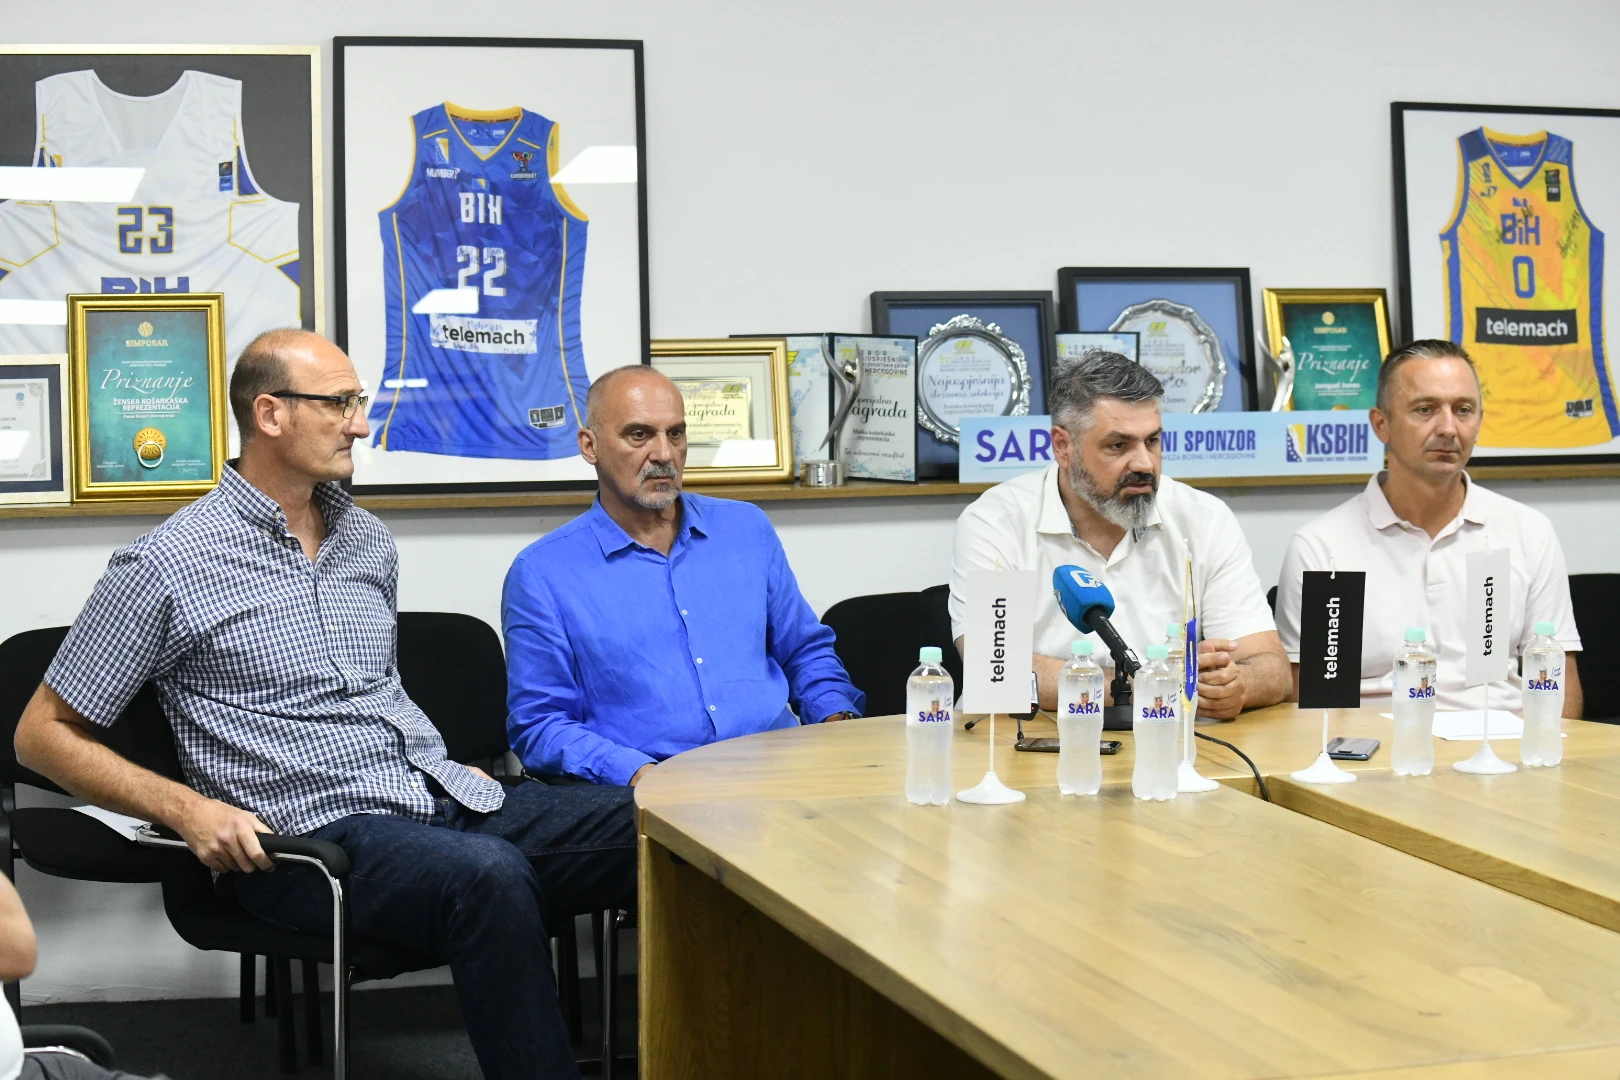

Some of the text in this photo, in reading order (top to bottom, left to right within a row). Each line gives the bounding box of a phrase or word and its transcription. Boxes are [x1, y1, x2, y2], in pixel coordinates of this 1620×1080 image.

[459, 192, 503, 225] BIH
[117, 205, 175, 254] 23
[1500, 213, 1541, 246] BiH
[456, 245, 507, 297] 22
[1512, 256, 1536, 299] 0
[442, 324, 525, 345] telemach
[1485, 317, 1569, 337] telemach
[125, 339, 168, 347] SIMPOSAR
[1298, 352, 1369, 382] Priznanje
[100, 368, 195, 398] Priznanje
[113, 397, 188, 406] ŽENSKA KOŠARKAŠKA
[685, 404, 735, 421] agrada
[851, 401, 909, 424] agrada
[856, 395, 892, 407] pecijalna
[975, 428, 1053, 463] SAR
[1184, 429, 1256, 452] SPONZOR
[1306, 423, 1369, 454] KSBIH
[1483, 575, 1495, 658] telemach
[990, 596, 1007, 683] telemach
[1323, 596, 1341, 680] telemach
[1408, 687, 1436, 699] SARA
[1528, 678, 1559, 692] SARA
[918, 709, 951, 723] SARA
[1068, 702, 1101, 715] SARA
[1142, 707, 1175, 719] SARA
